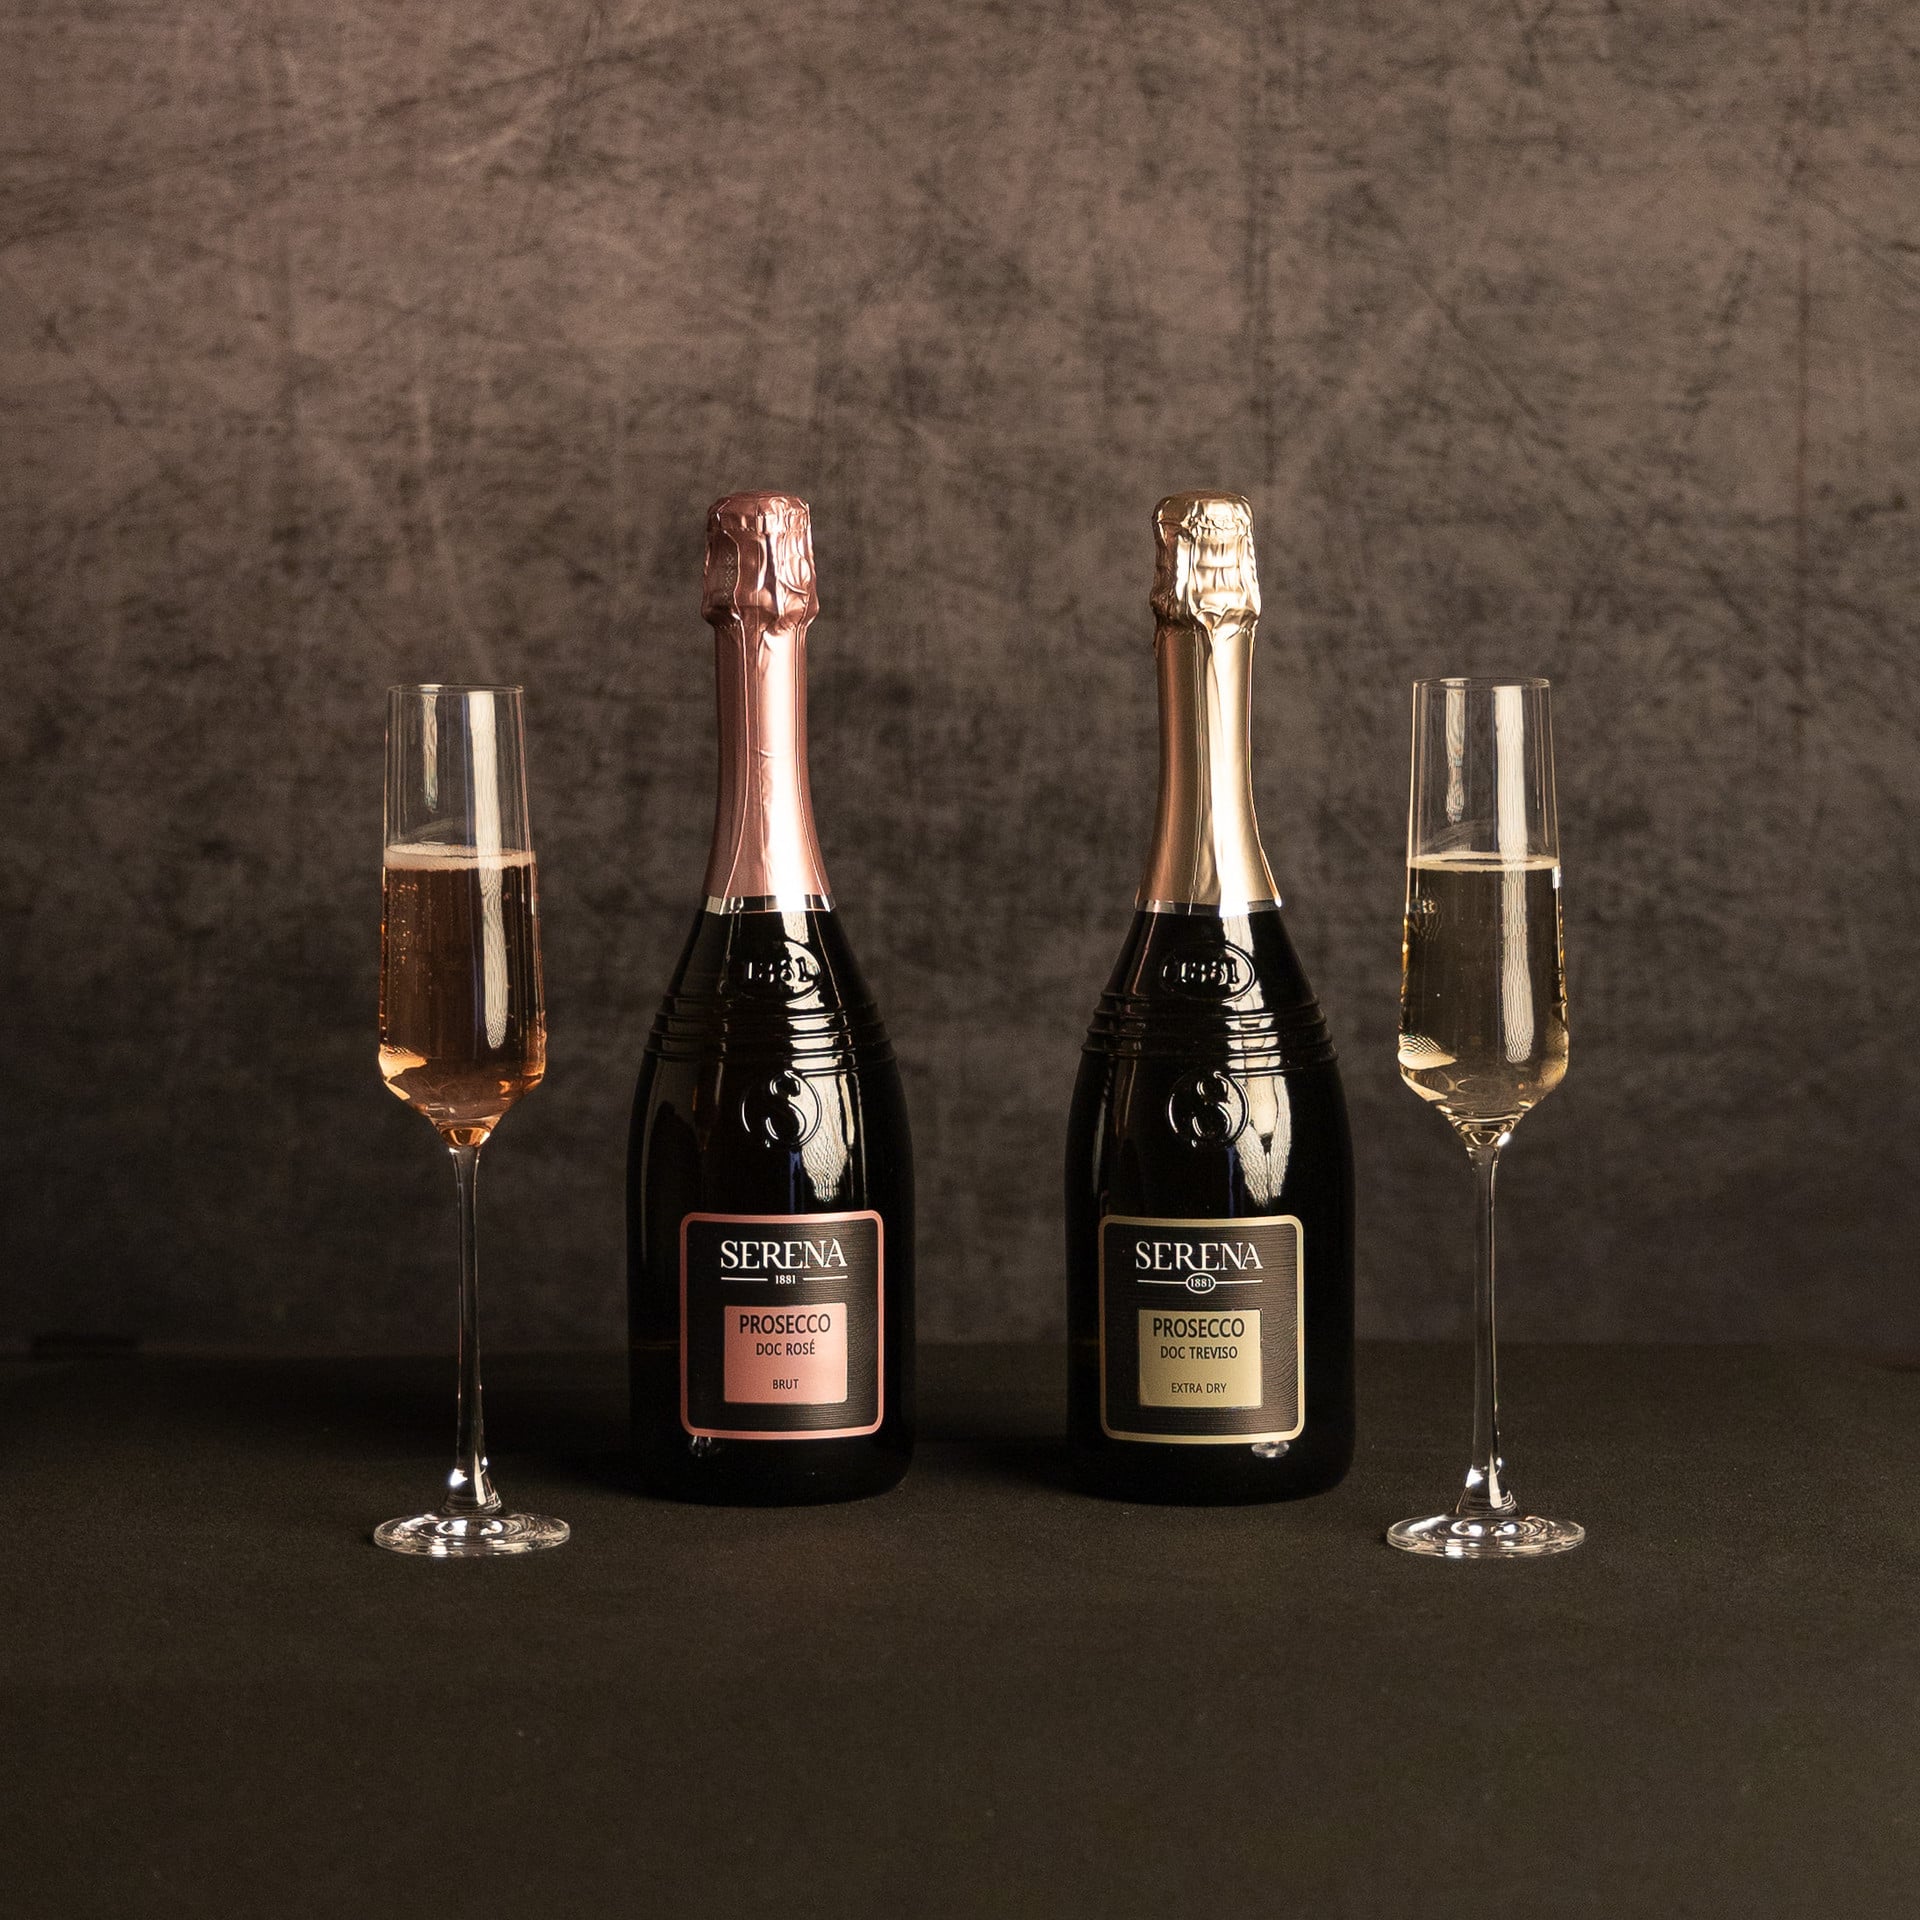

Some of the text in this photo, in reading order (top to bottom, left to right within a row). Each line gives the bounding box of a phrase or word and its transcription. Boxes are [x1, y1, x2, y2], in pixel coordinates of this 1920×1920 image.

[721, 1238, 847, 1270] SERENA
[1136, 1241, 1263, 1271] SERENA
[775, 1275, 795, 1285] 1881
[1190, 1278, 1212, 1288] 1881
[739, 1314, 830, 1334] PROSECCO
[1153, 1318, 1245, 1338] PROSECCO
[756, 1339, 815, 1356] DOC ROSÉ
[1160, 1346, 1238, 1359] DOC TREVISO
[773, 1379, 799, 1389] BRUT
[1171, 1383, 1227, 1393] EXTRA DRY
